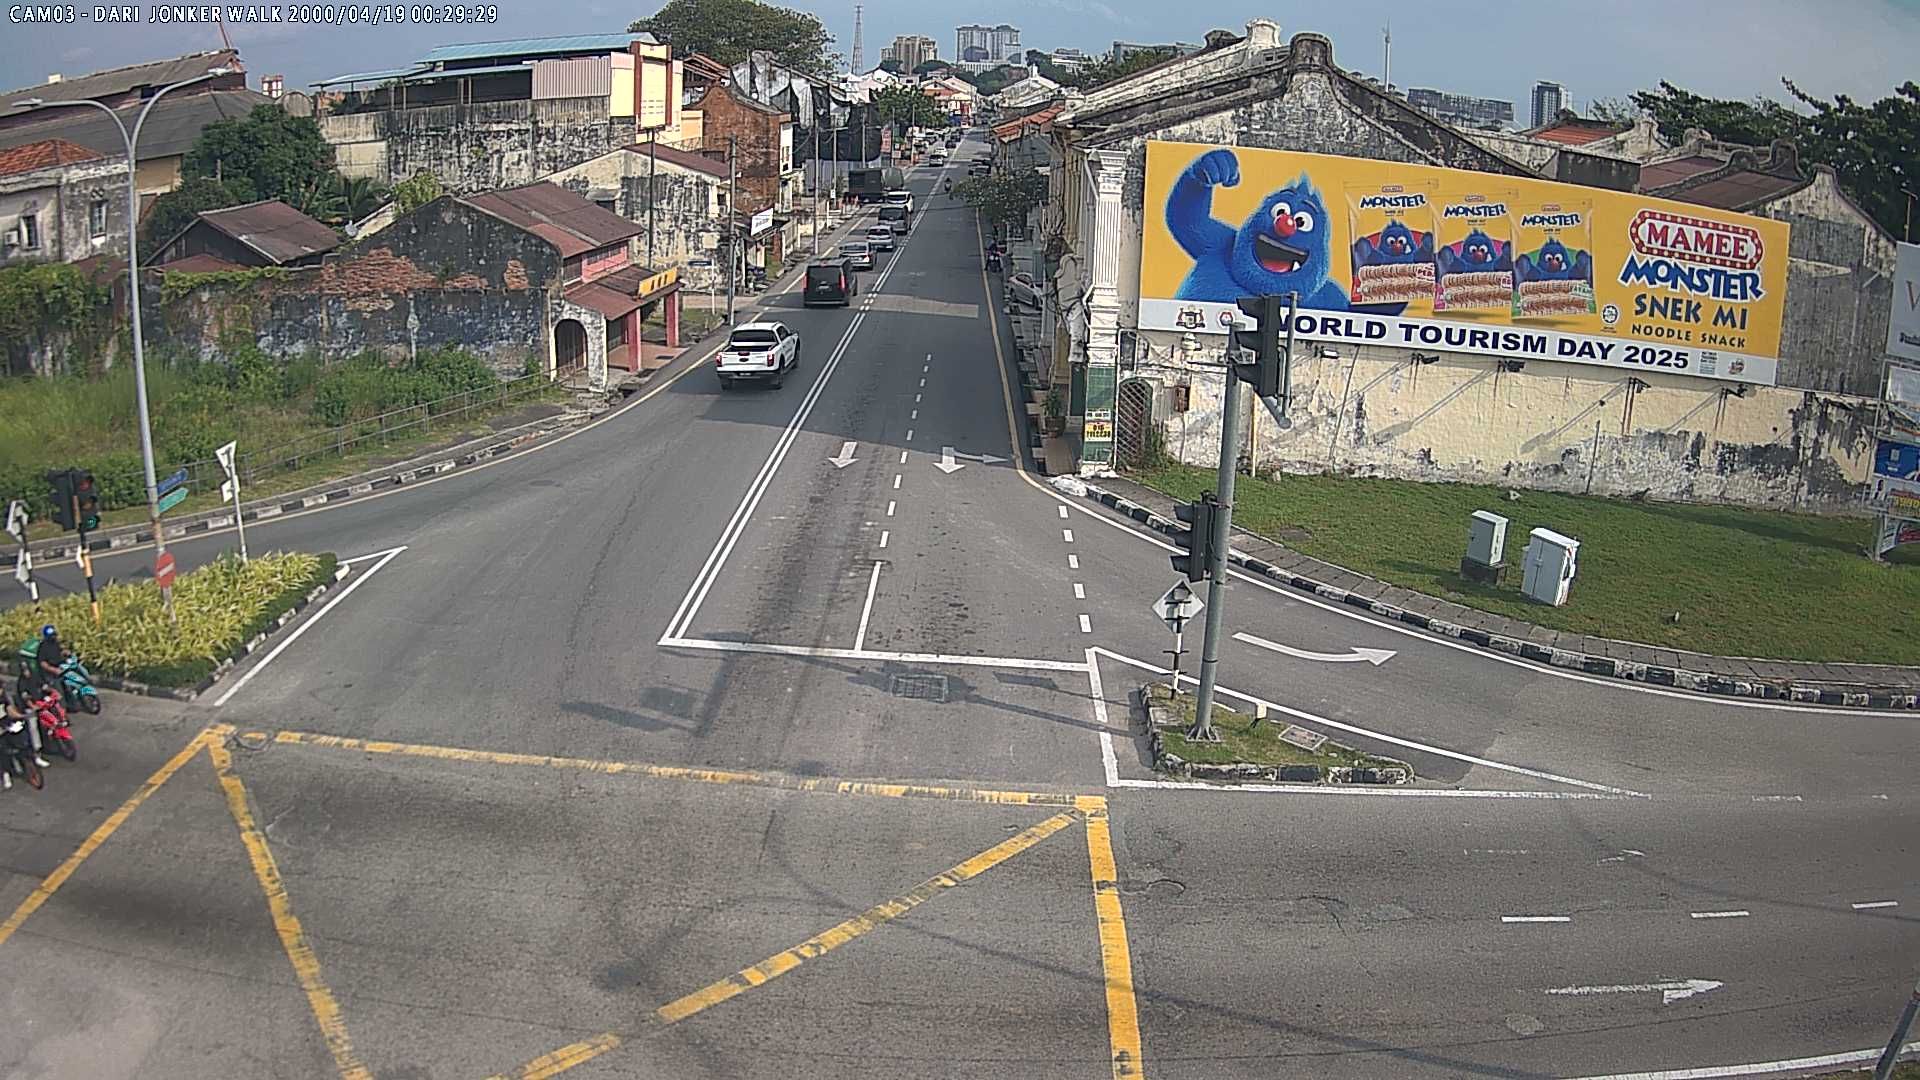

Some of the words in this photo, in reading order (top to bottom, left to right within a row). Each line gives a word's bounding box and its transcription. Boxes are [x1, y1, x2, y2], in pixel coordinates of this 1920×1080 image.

[1360, 194, 1426, 208] MONSTER
[1444, 203, 1507, 218] MONSTER
[1521, 213, 1581, 226] MONSTER
[1647, 222, 1748, 260] MAMEE
[1620, 255, 1763, 300] MONSTER
[1634, 293, 1702, 323] SNEK
[1712, 305, 1748, 330] MI
[1399, 323, 1547, 354] TOURISM
[1557, 339, 1616, 361] DAY
[1623, 345, 1689, 369] 2025
[1631, 324, 1692, 341] NOODLE
[1700, 332, 1746, 348] SNACK
